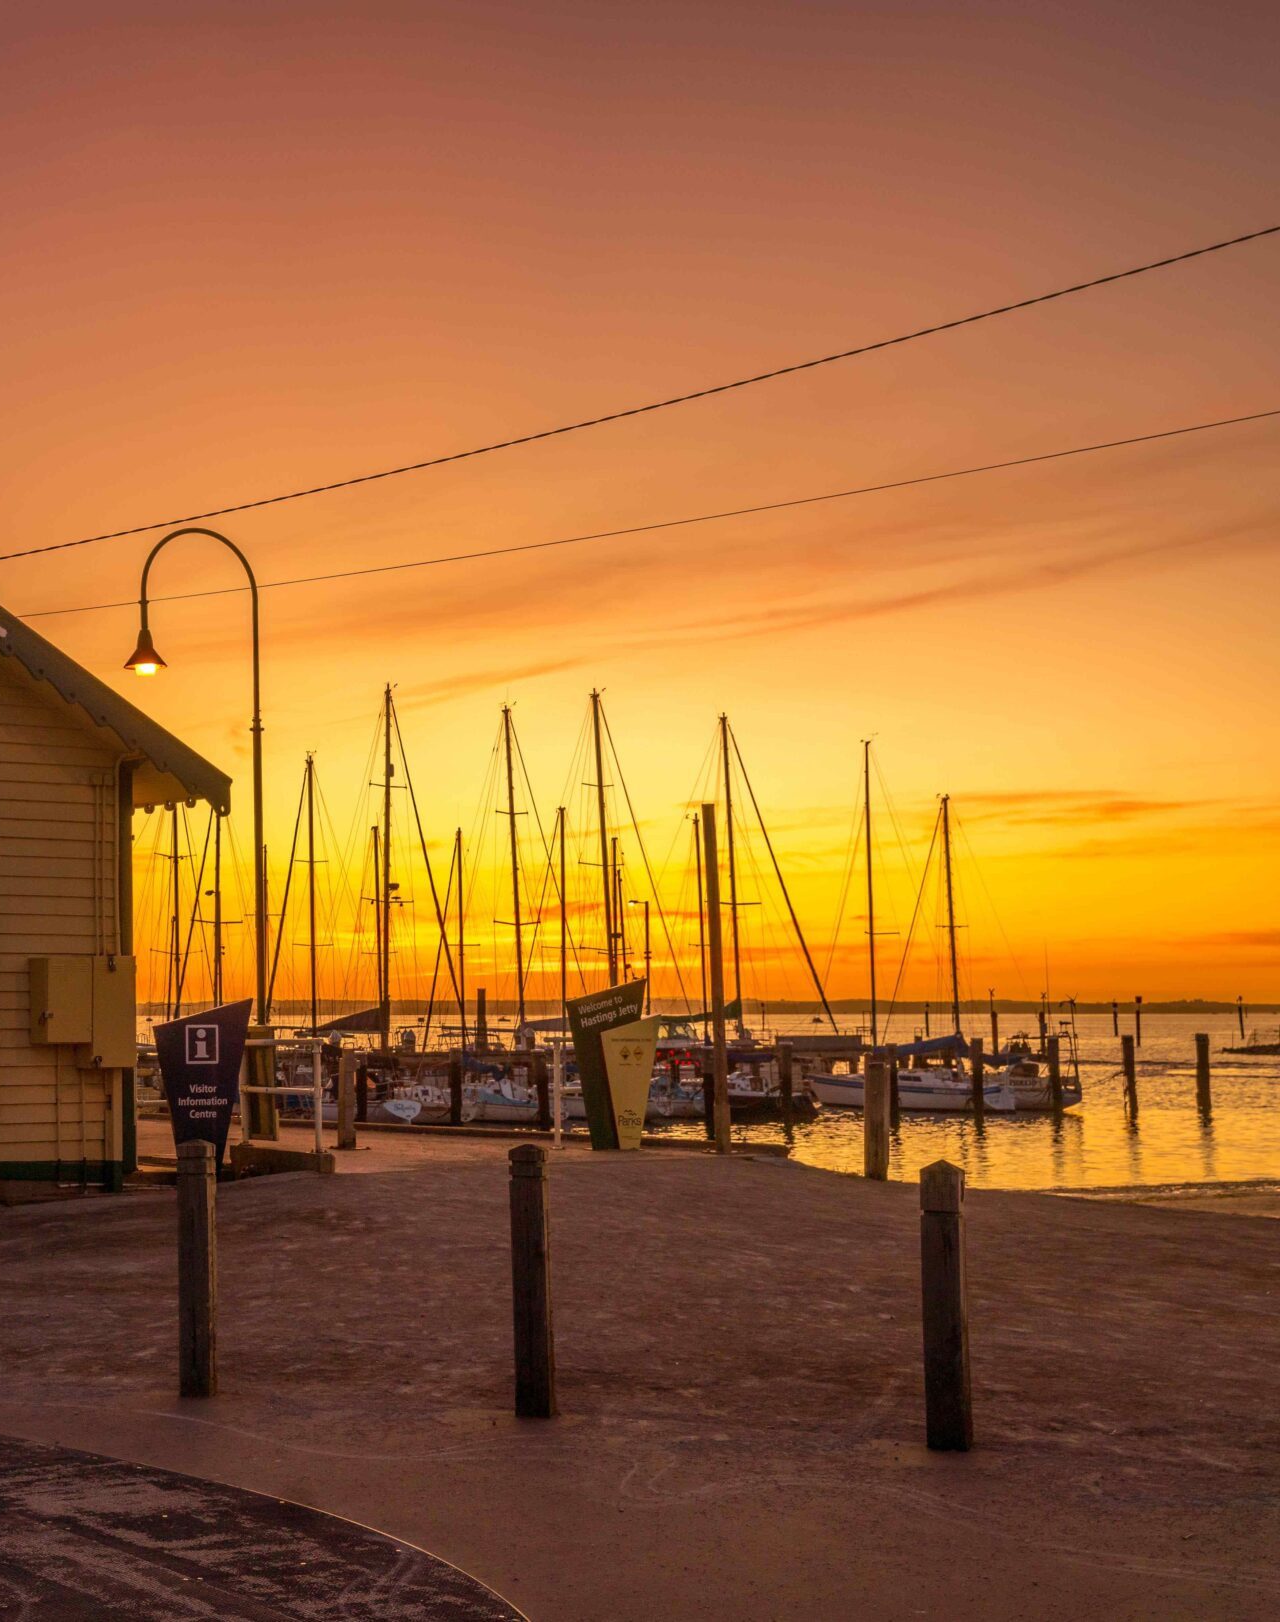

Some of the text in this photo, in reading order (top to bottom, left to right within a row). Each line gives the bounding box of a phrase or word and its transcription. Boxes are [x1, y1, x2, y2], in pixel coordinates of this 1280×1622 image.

[578, 995, 623, 1015] Welcome to
[581, 1004, 639, 1028] Hastings Jetty
[189, 1084, 217, 1093] Visitor
[178, 1097, 228, 1106] Information
[189, 1109, 217, 1119] Centre
[618, 1115, 642, 1126] Parks
